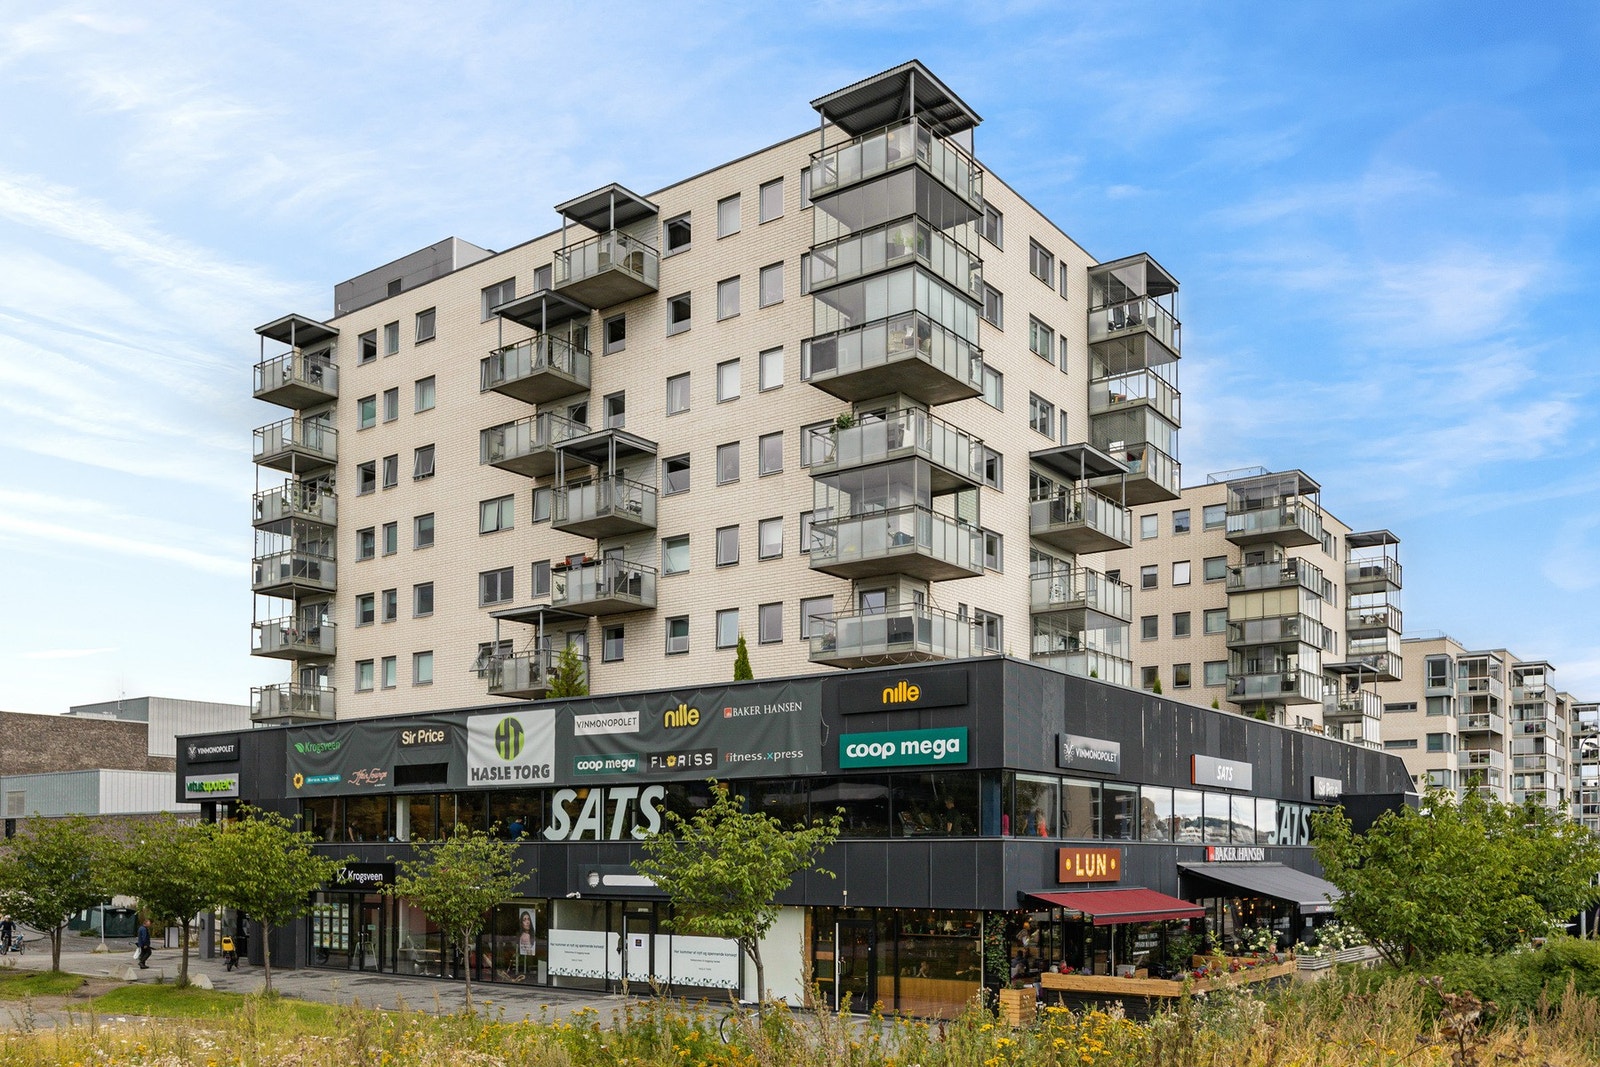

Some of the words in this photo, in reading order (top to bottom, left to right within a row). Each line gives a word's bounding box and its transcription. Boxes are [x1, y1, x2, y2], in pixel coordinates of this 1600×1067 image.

[882, 681, 920, 704] nille
[664, 703, 700, 728] nille
[732, 705, 761, 717] BAKER
[764, 702, 802, 714] HANSEN
[576, 717, 637, 728] VINMONOPOLET
[402, 730, 417, 745] Sir
[418, 729, 444, 743] Price
[197, 745, 234, 754] VINMONOPOLET
[305, 741, 341, 754] Krogsveen
[846, 742, 896, 759] coop
[901, 738, 960, 760] mega
[1075, 747, 1117, 763] VINMONOPOLET
[471, 766, 511, 781] HASLE
[514, 764, 550, 779] TORG
[577, 760, 603, 771] coop
[605, 758, 636, 772] mega
[1217, 765, 1233, 782] SATS
[543, 785, 665, 840] SATS
[1214, 847, 1236, 860] BAKER
[1237, 847, 1264, 861] HANSEN
[1076, 853, 1107, 877] LUN
[348, 870, 383, 884] Krogsveen
